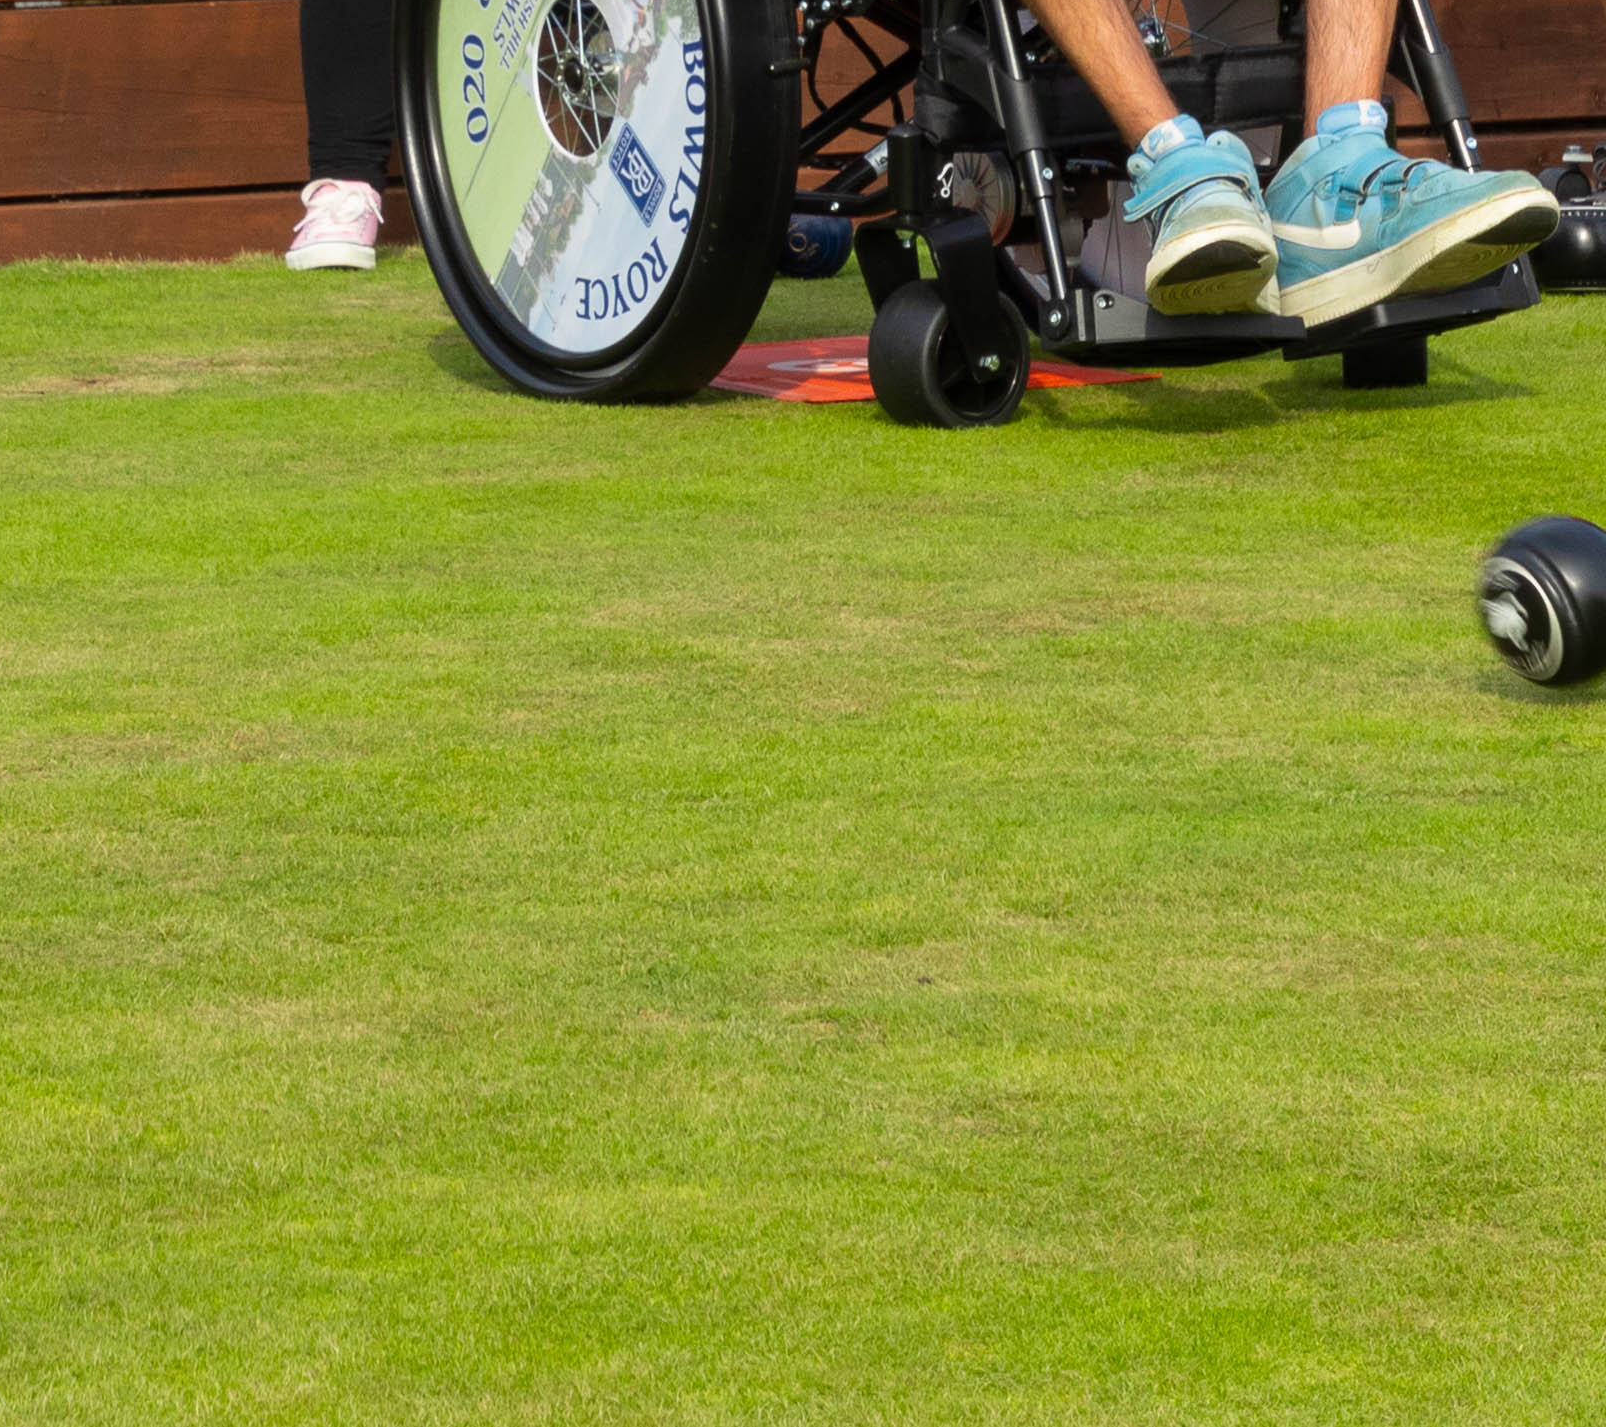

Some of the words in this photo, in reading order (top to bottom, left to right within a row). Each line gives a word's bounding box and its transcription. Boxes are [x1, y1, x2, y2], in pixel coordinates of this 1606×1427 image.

[462, 34, 489, 144] 020
[500, 28, 522, 70] HILL
[668, 37, 706, 234] BOWLS
[575, 236, 668, 320] ROYCE
